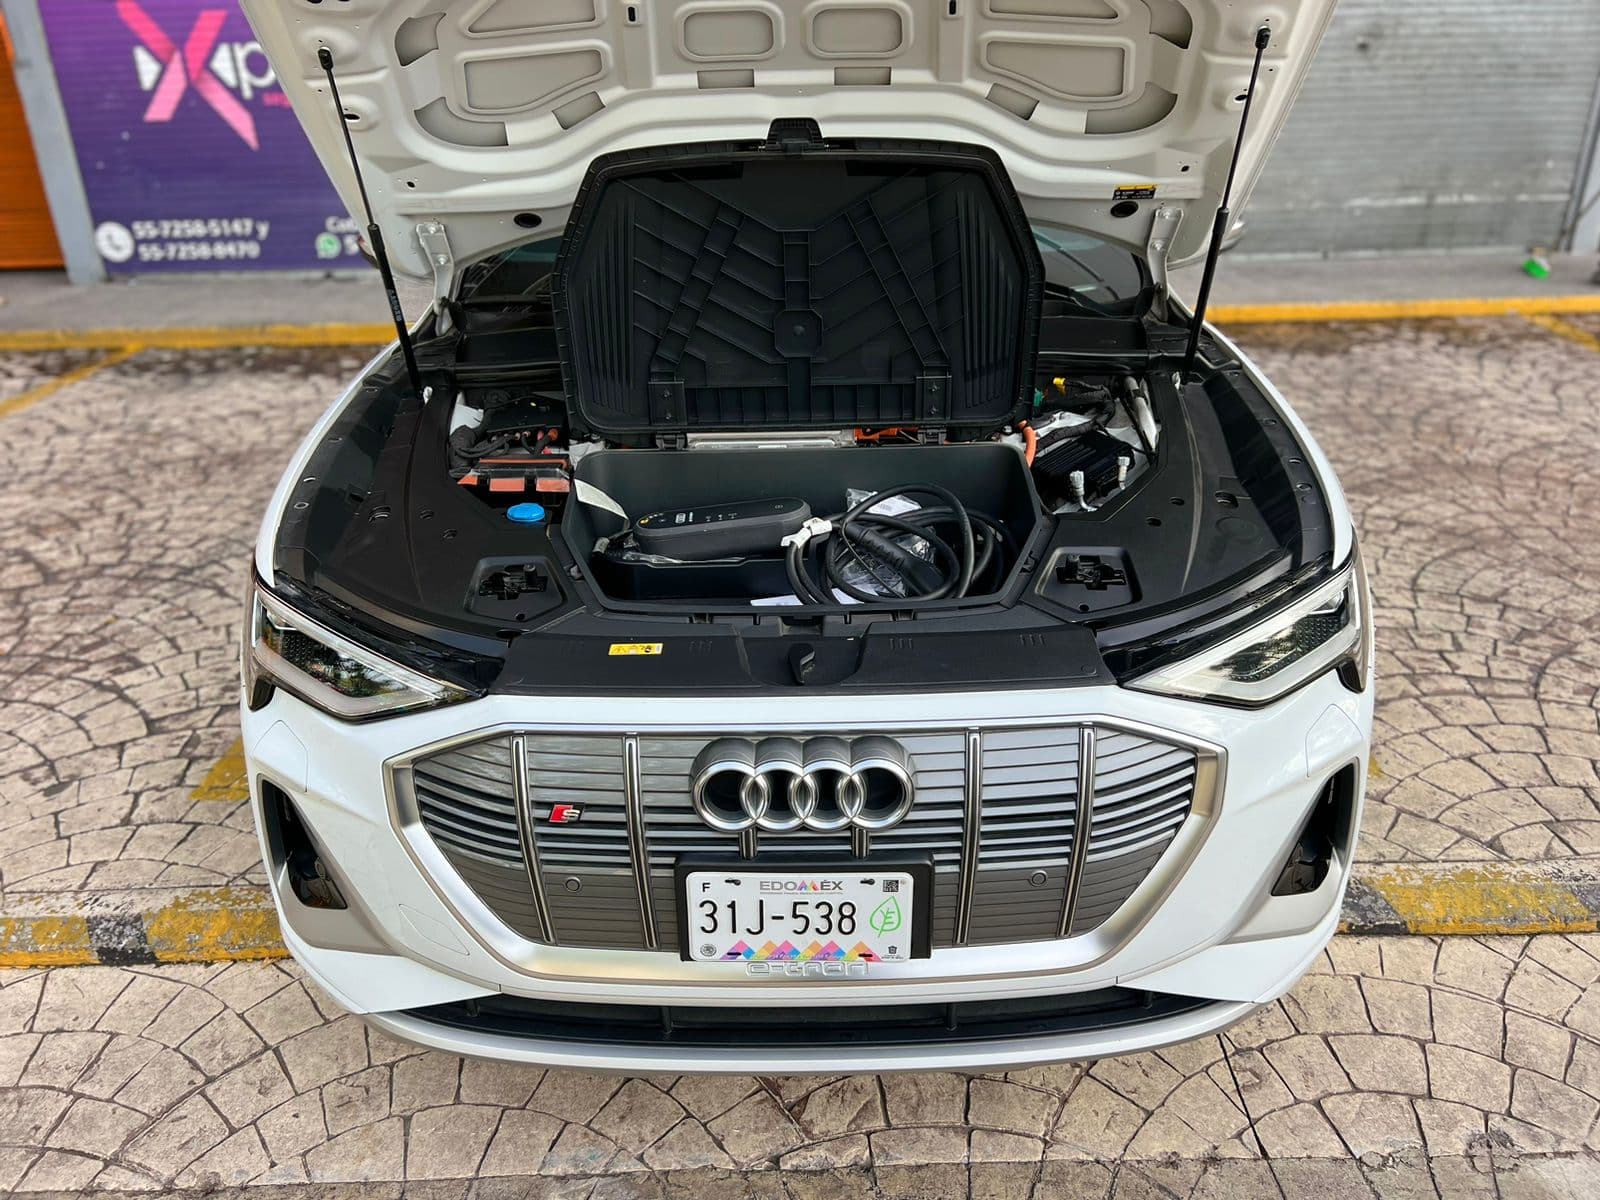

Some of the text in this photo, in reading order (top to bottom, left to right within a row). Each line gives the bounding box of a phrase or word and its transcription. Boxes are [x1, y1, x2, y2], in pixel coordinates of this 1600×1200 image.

[132, 218, 270, 240] 55-7258-5147 y
[702, 882, 710, 892] F
[699, 899, 857, 936] 31J-538
[746, 961, 868, 976] e-tron
